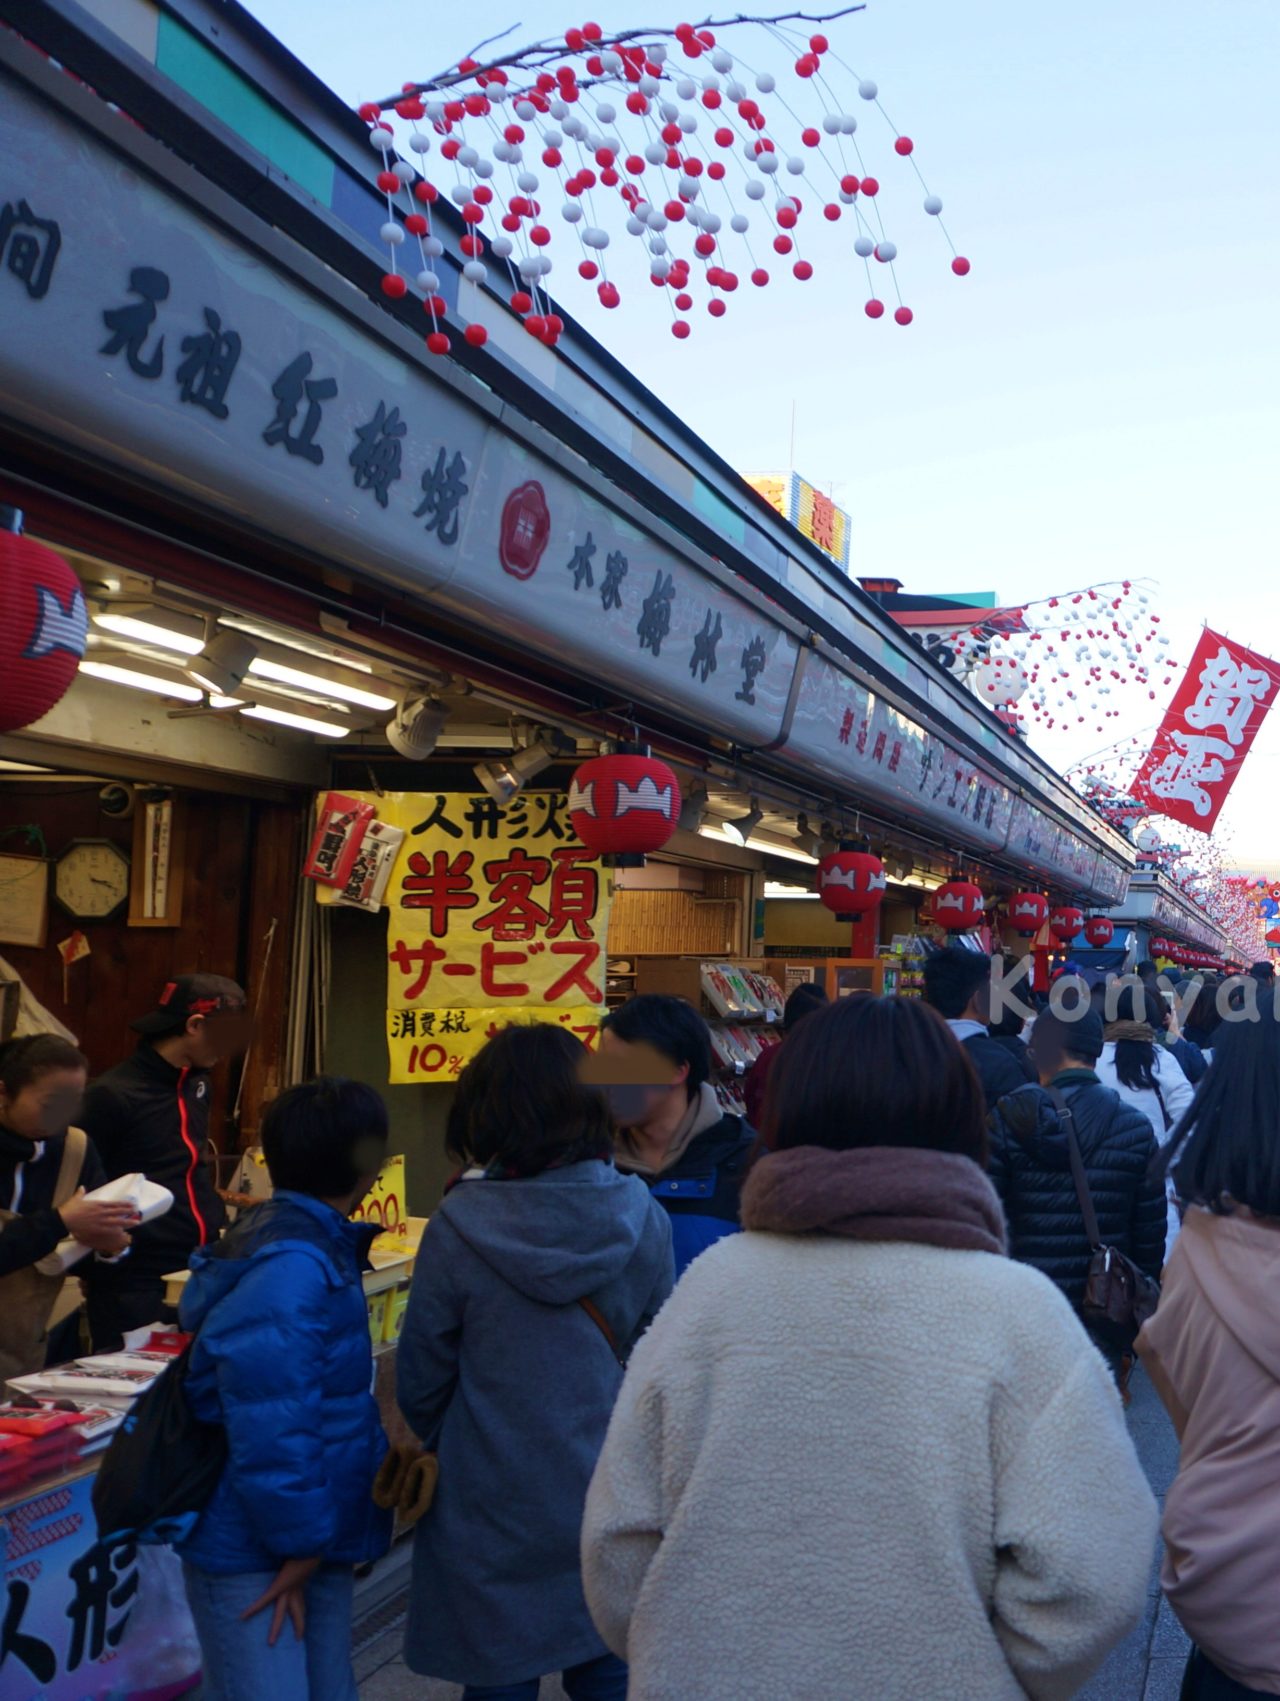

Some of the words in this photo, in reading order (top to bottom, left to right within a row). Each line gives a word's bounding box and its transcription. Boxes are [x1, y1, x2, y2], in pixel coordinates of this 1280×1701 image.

[400, 846, 601, 942] 半額
[389, 939, 604, 1005] サービス
[391, 1010, 471, 1038] 消費税
